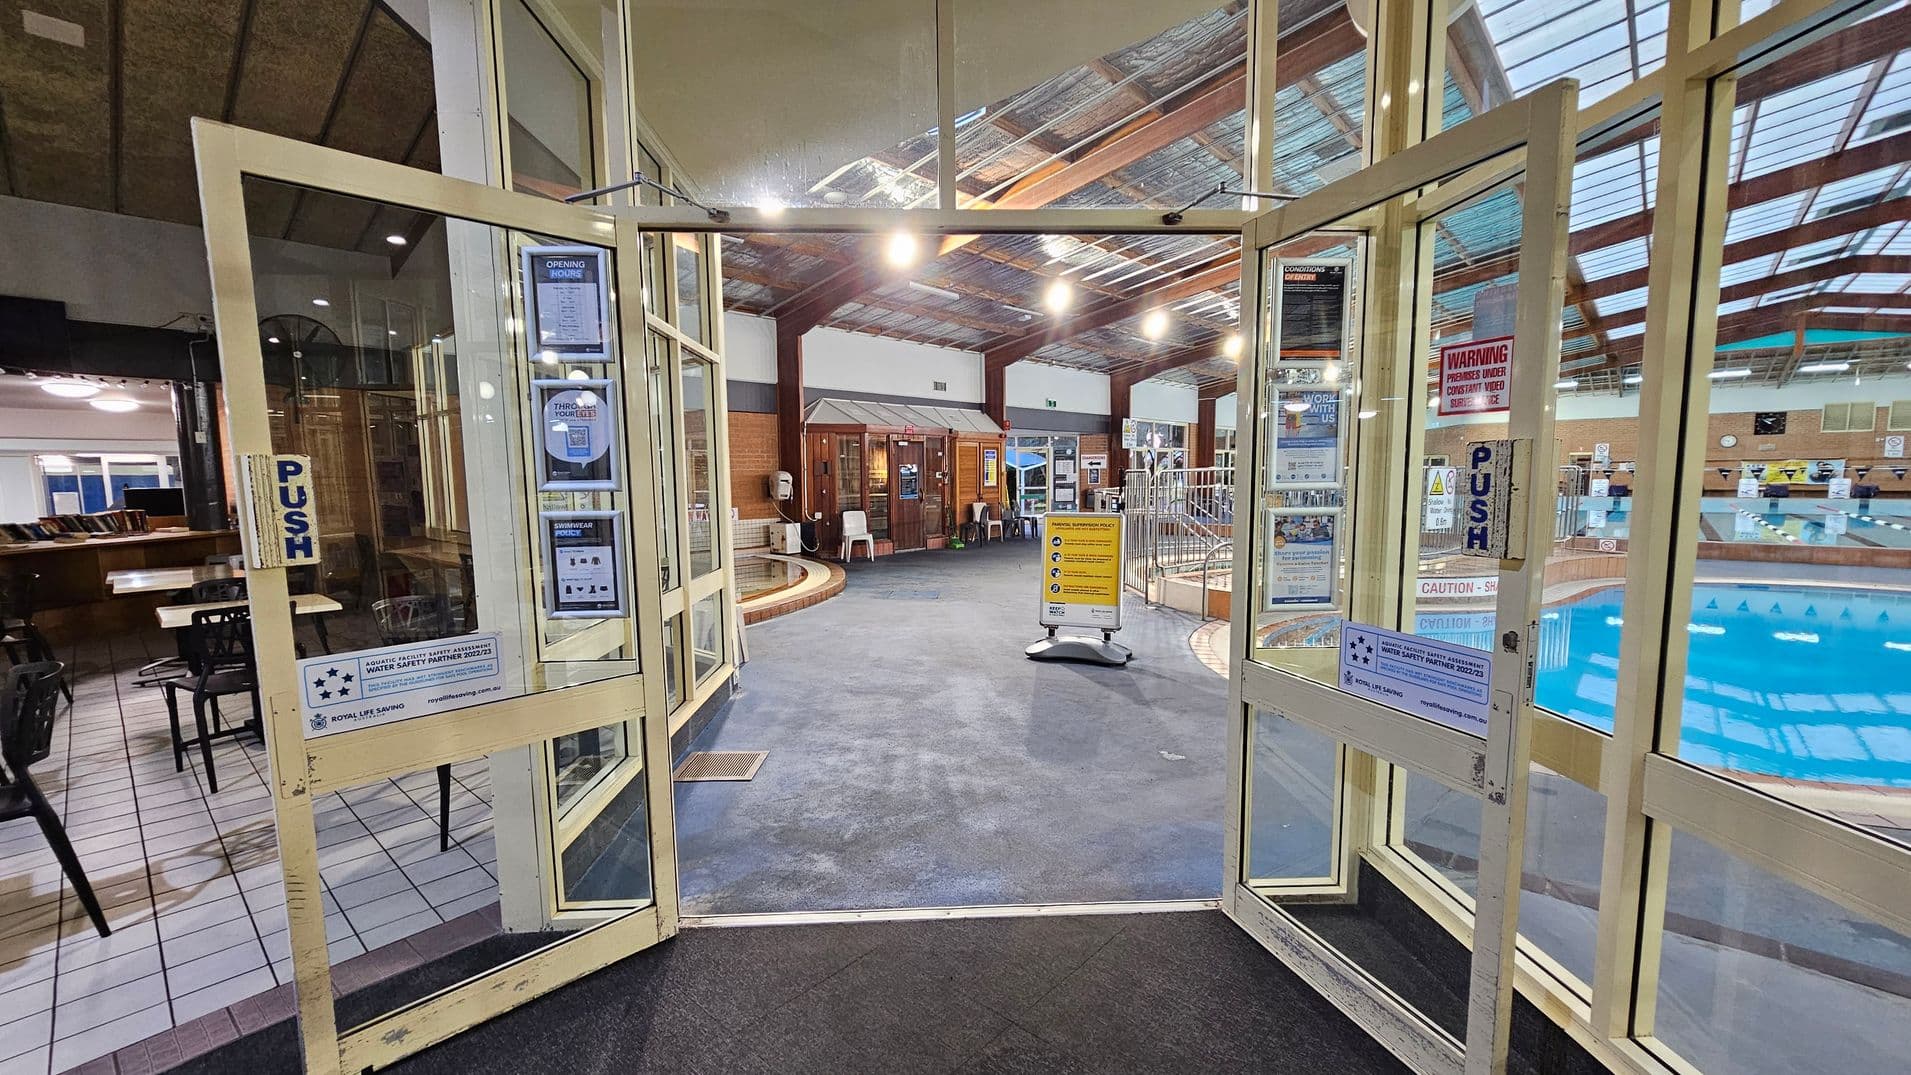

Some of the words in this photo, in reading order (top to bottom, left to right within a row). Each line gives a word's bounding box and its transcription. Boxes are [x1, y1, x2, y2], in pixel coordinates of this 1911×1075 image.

[551, 269, 582, 278] HOURS
[1448, 344, 1508, 370] WARNING
[1446, 370, 1480, 383] PREMISES
[1482, 367, 1506, 378] UNDER
[1304, 394, 1336, 404] WORK
[1446, 383, 1482, 396] CONSTANT
[1485, 380, 1504, 392] VIDEO
[1310, 404, 1336, 413] WITH
[1322, 414, 1336, 423] US
[277, 460, 313, 559] PUSH
[1467, 447, 1492, 550] PUSH
[1422, 582, 1474, 594] CAUTION
[366, 658, 396, 666] AQUATIC
[399, 653, 426, 661] FACILITY
[429, 649, 450, 658] SAFETY
[453, 643, 491, 653] ASSESSMENT
[366, 664, 395, 674] WATER
[396, 660, 426, 668] SAFETY
[428, 654, 462, 664] PARTNER
[464, 648, 492, 658] 2022/23
[1382, 641, 1402, 649] AQUATIC
[1404, 646, 1426, 654] FACILITY
[1428, 652, 1446, 660] SAFETY
[1448, 656, 1484, 669] ASSESSMENT
[1382, 646, 1400, 656] WATER
[1402, 651, 1424, 662] SAFETY
[1426, 656, 1454, 670] PARTNER
[1456, 665, 1484, 678] 2022/23
[332, 712, 356, 722] ROYAL
[360, 708, 376, 718] LIFE
[376, 703, 404, 714] SAVING
[428, 686, 502, 704] royallifesaving.com.au
[1356, 679, 1371, 688] ROYAL
[1382, 686, 1404, 698] SAVING
[1420, 700, 1488, 724] royallifesaving.com.au
